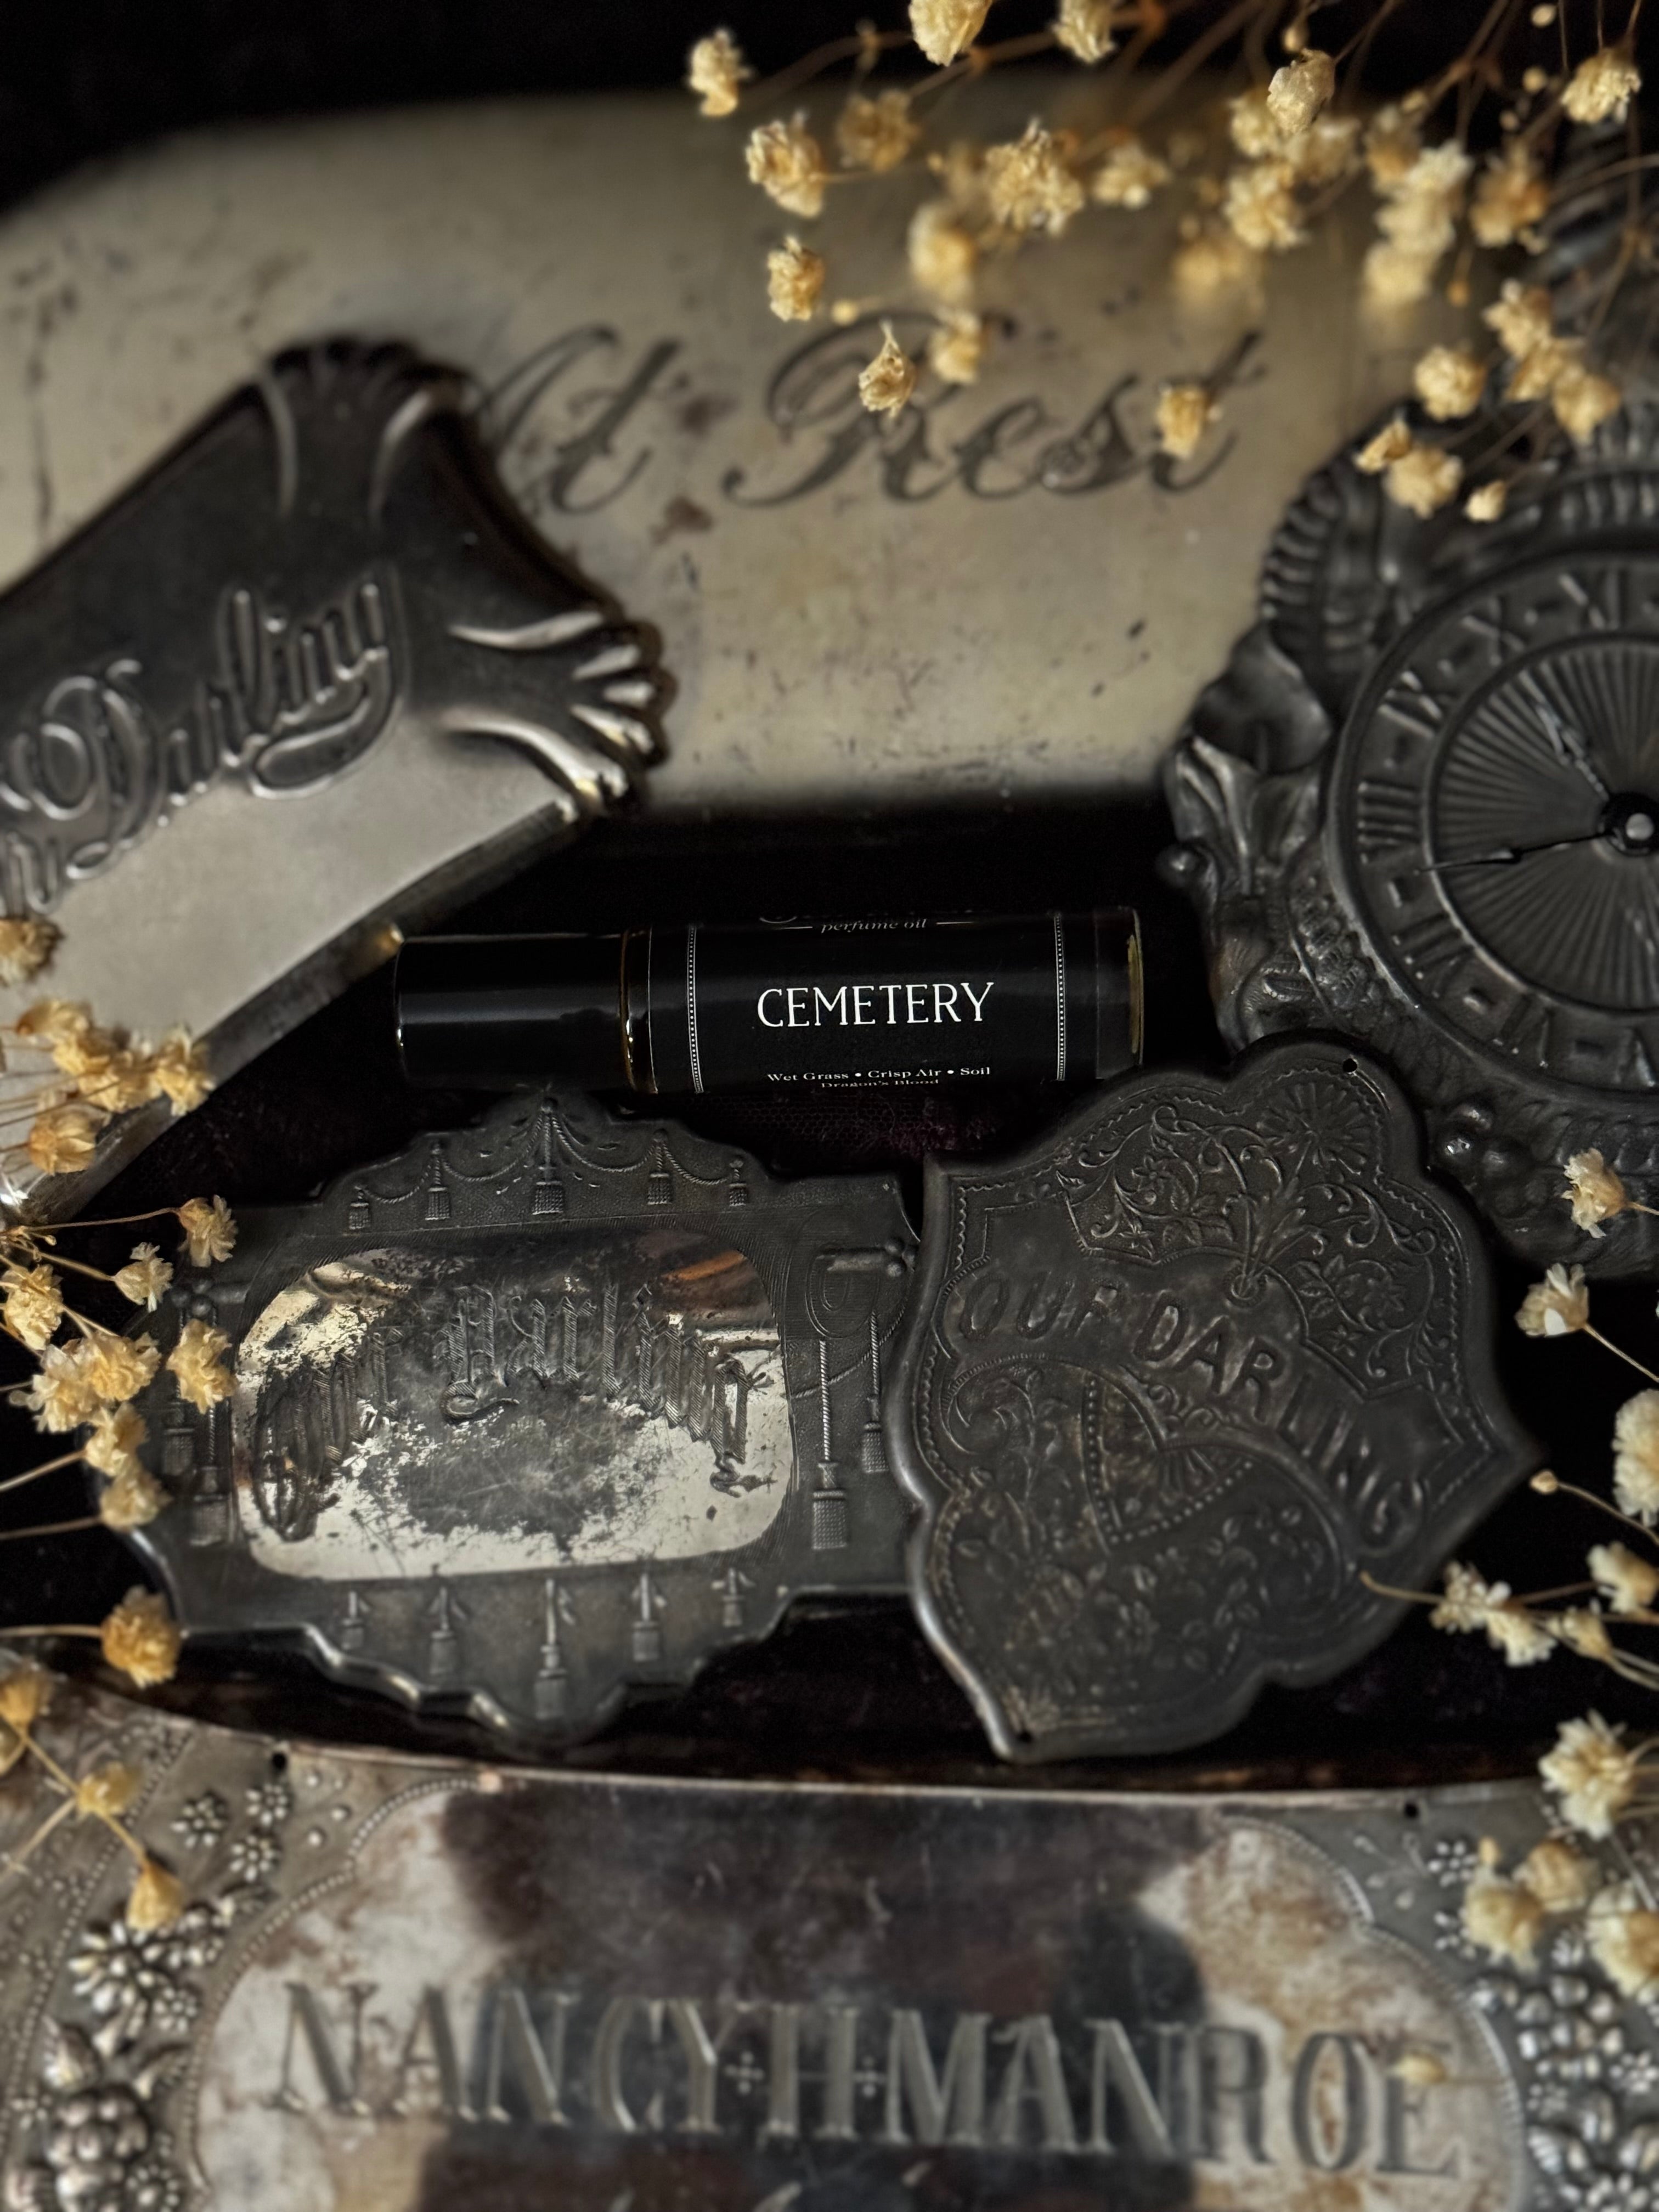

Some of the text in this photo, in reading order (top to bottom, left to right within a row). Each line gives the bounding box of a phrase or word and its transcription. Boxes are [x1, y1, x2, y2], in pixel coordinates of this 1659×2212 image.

[720, 308, 1267, 510] Rest
[0, 580, 405, 881] Darling
[756, 981, 995, 1029] CEMETERY
[820, 917, 928, 934] perfume oil
[766, 1066, 991, 1082] Wet Grass Crisp Air Soil
[821, 1080, 889, 1088] Dragon's
[435, 1280, 779, 1499] Darling
[957, 1267, 1425, 1549] OUR DARLING
[261, 1978, 757, 2135] NANCY
[874, 2005, 1470, 2179] MANROE
